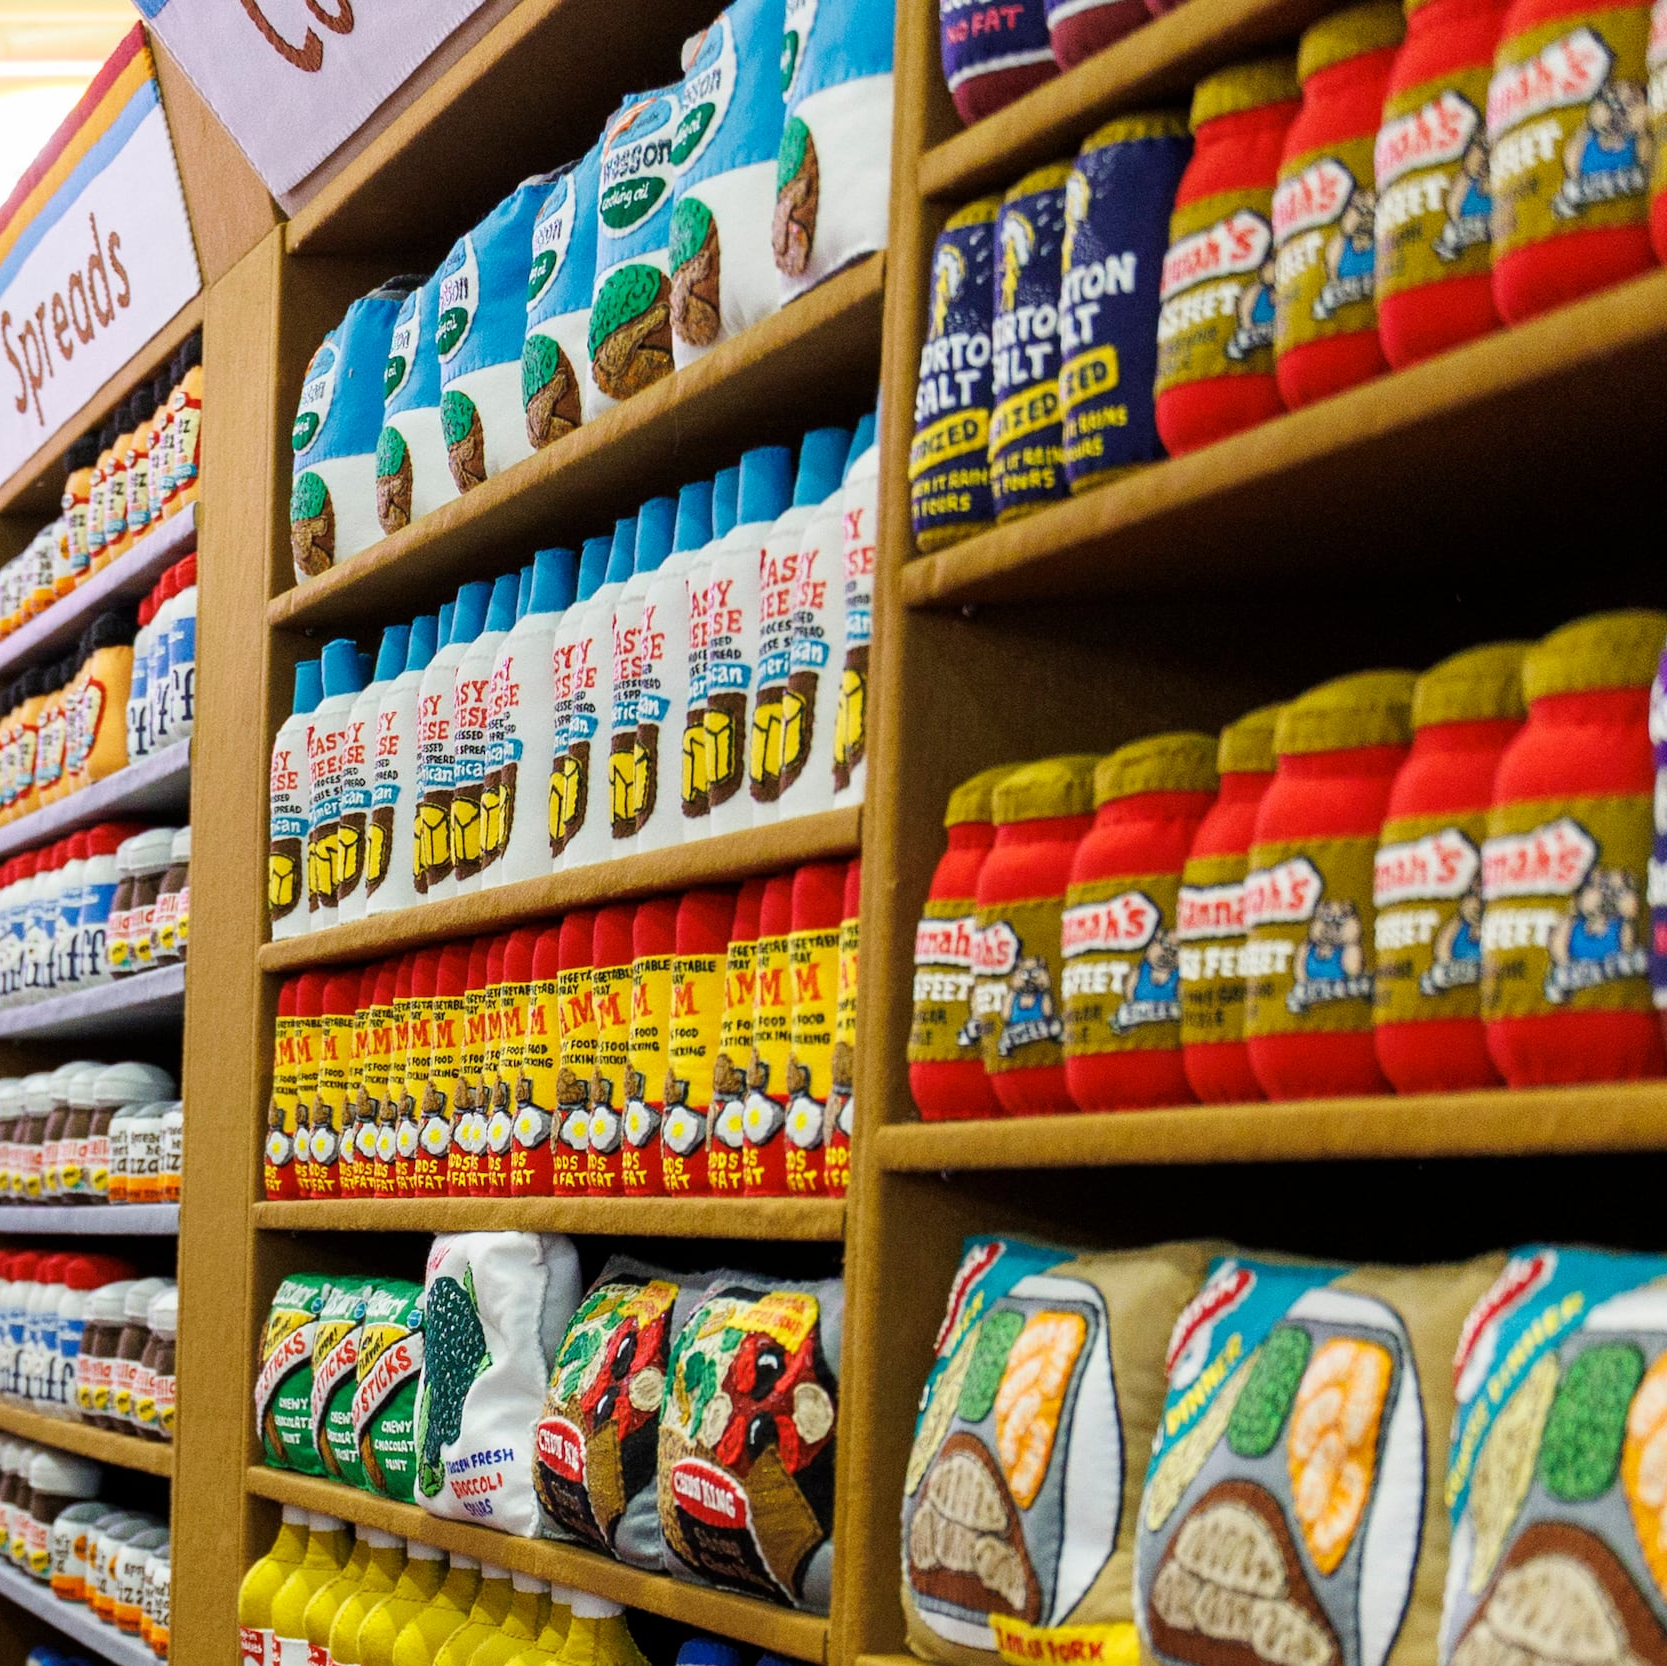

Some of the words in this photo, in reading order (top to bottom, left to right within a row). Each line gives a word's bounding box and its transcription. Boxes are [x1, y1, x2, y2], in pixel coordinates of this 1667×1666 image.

[0, 213, 131, 426] Spreads
[922, 330, 990, 371] ORTO
[759, 1016, 786, 1027] FOOD
[674, 1028, 699, 1039] FOOD
[418, 1175, 445, 1189] FAT
[380, 1419, 413, 1436] CHEWY
[374, 1438, 414, 1455] CHOCOLAT
[470, 1447, 515, 1469] FRESH
